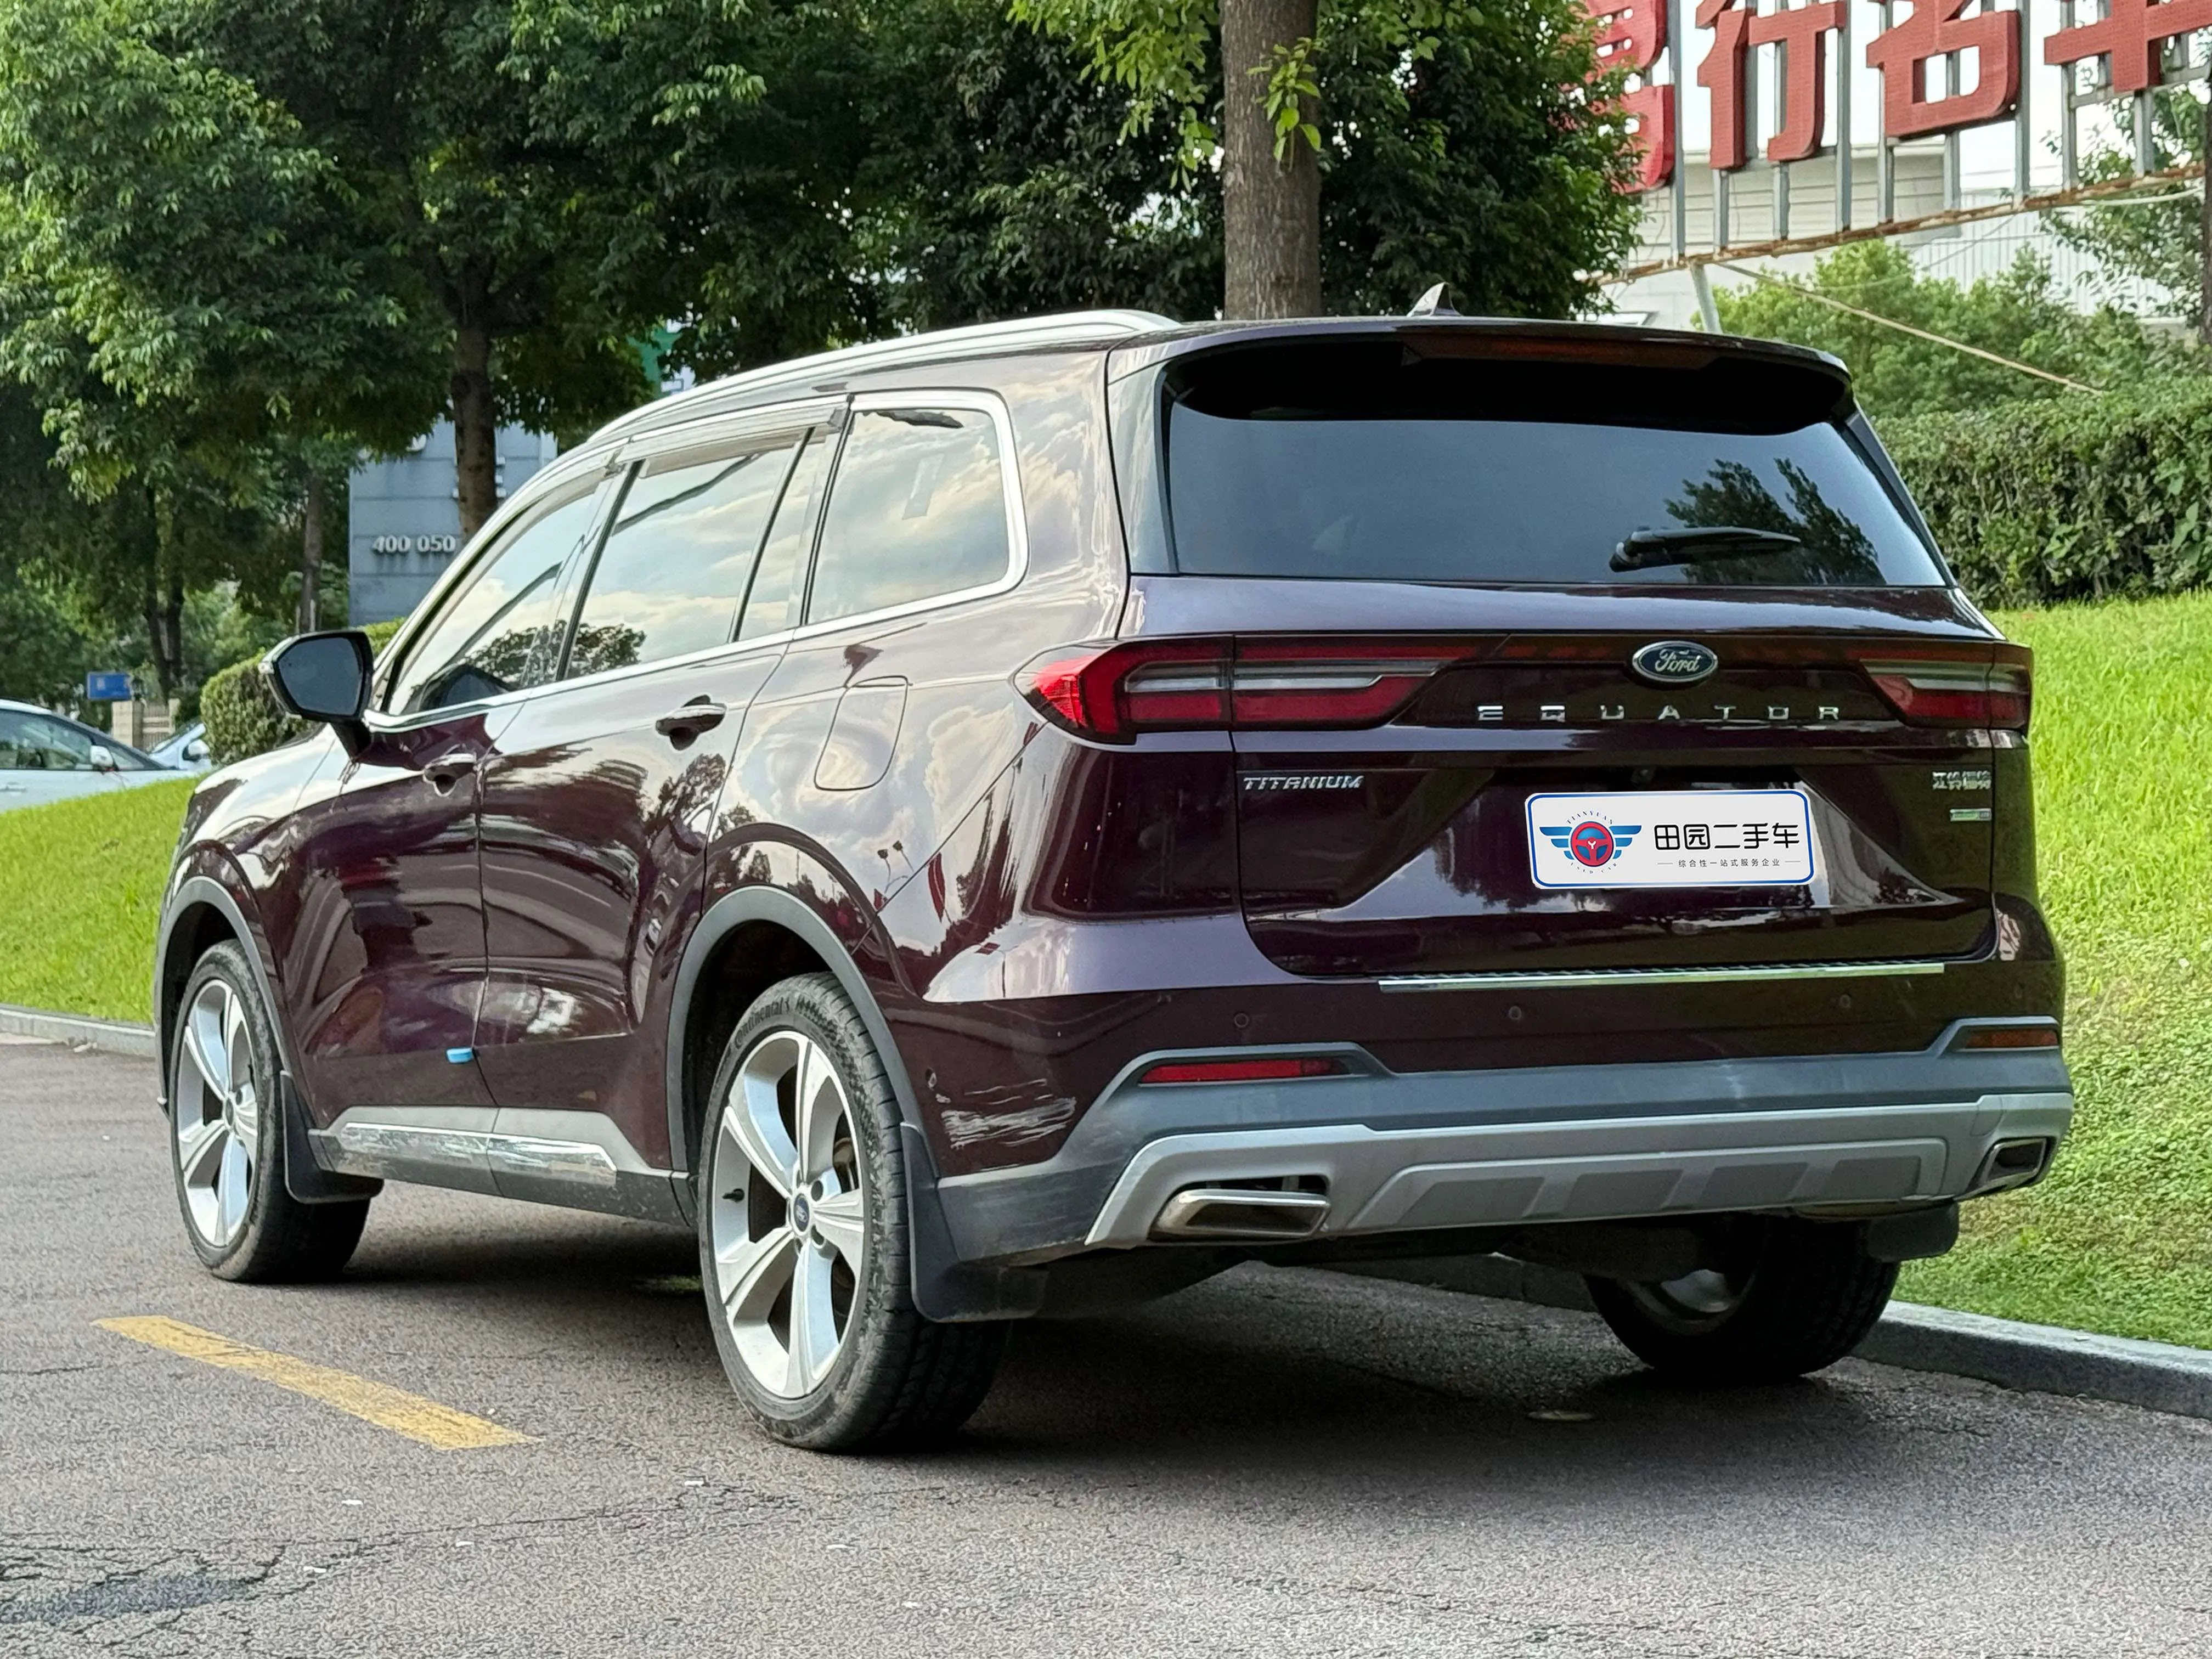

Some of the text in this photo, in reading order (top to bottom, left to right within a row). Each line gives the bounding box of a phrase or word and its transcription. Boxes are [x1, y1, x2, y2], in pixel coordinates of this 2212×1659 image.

[372, 534, 456, 554] 400 050
[1655, 648, 1700, 672] Ford
[1477, 704, 1839, 723] EQUATOR
[1243, 775, 1365, 790] TITANIUM
